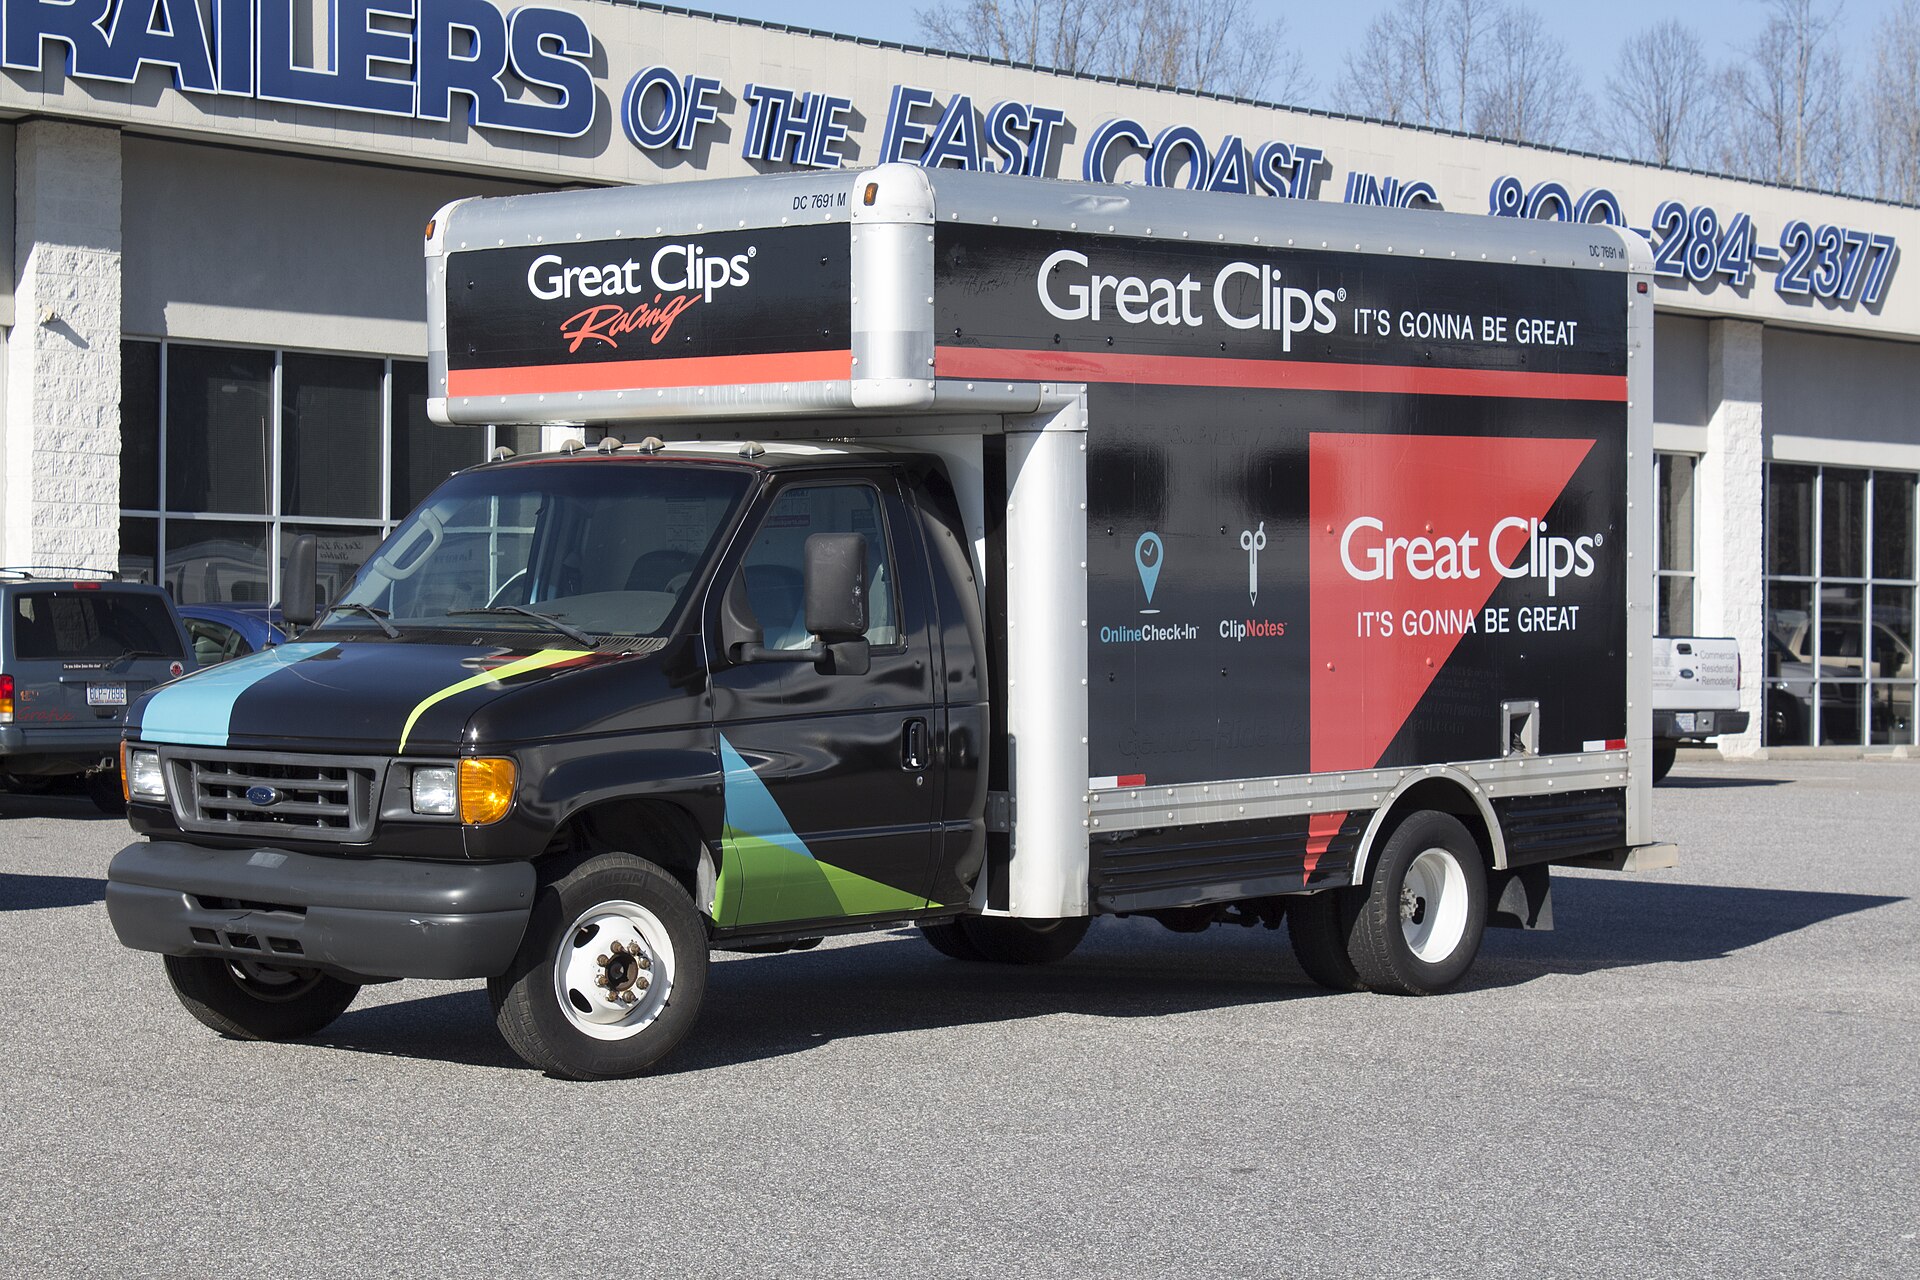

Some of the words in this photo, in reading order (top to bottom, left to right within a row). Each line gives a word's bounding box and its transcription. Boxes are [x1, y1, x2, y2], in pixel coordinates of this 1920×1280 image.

[621, 64, 722, 151] OF
[742, 82, 852, 168] THE
[879, 84, 1066, 177] EAST
[1083, 117, 1324, 200] COAST
[793, 196, 808, 210] DC
[811, 193, 834, 209] 7691
[837, 192, 847, 206] M
[1589, 245, 1600, 258] DC
[1601, 246, 1617, 259] 7691
[1618, 248, 1625, 259] M
[527, 254, 642, 300] Great
[1037, 249, 1203, 327] Great
[1353, 308, 1391, 337] IT'S
[1399, 312, 1474, 342] GONNA
[1481, 316, 1508, 343] BE
[1515, 318, 1578, 347] GREAT
[560, 292, 703, 354] Racing
[1340, 516, 1481, 581] Great
[1357, 611, 1394, 638] IT'S
[1402, 608, 1477, 637] GONNA
[1484, 607, 1510, 634] BE
[1518, 605, 1580, 632] GREAT
[1699, 650, 1736, 660] Commercial
[1701, 663, 1734, 674] Residential
[1701, 676, 1736, 687] Remodeling
